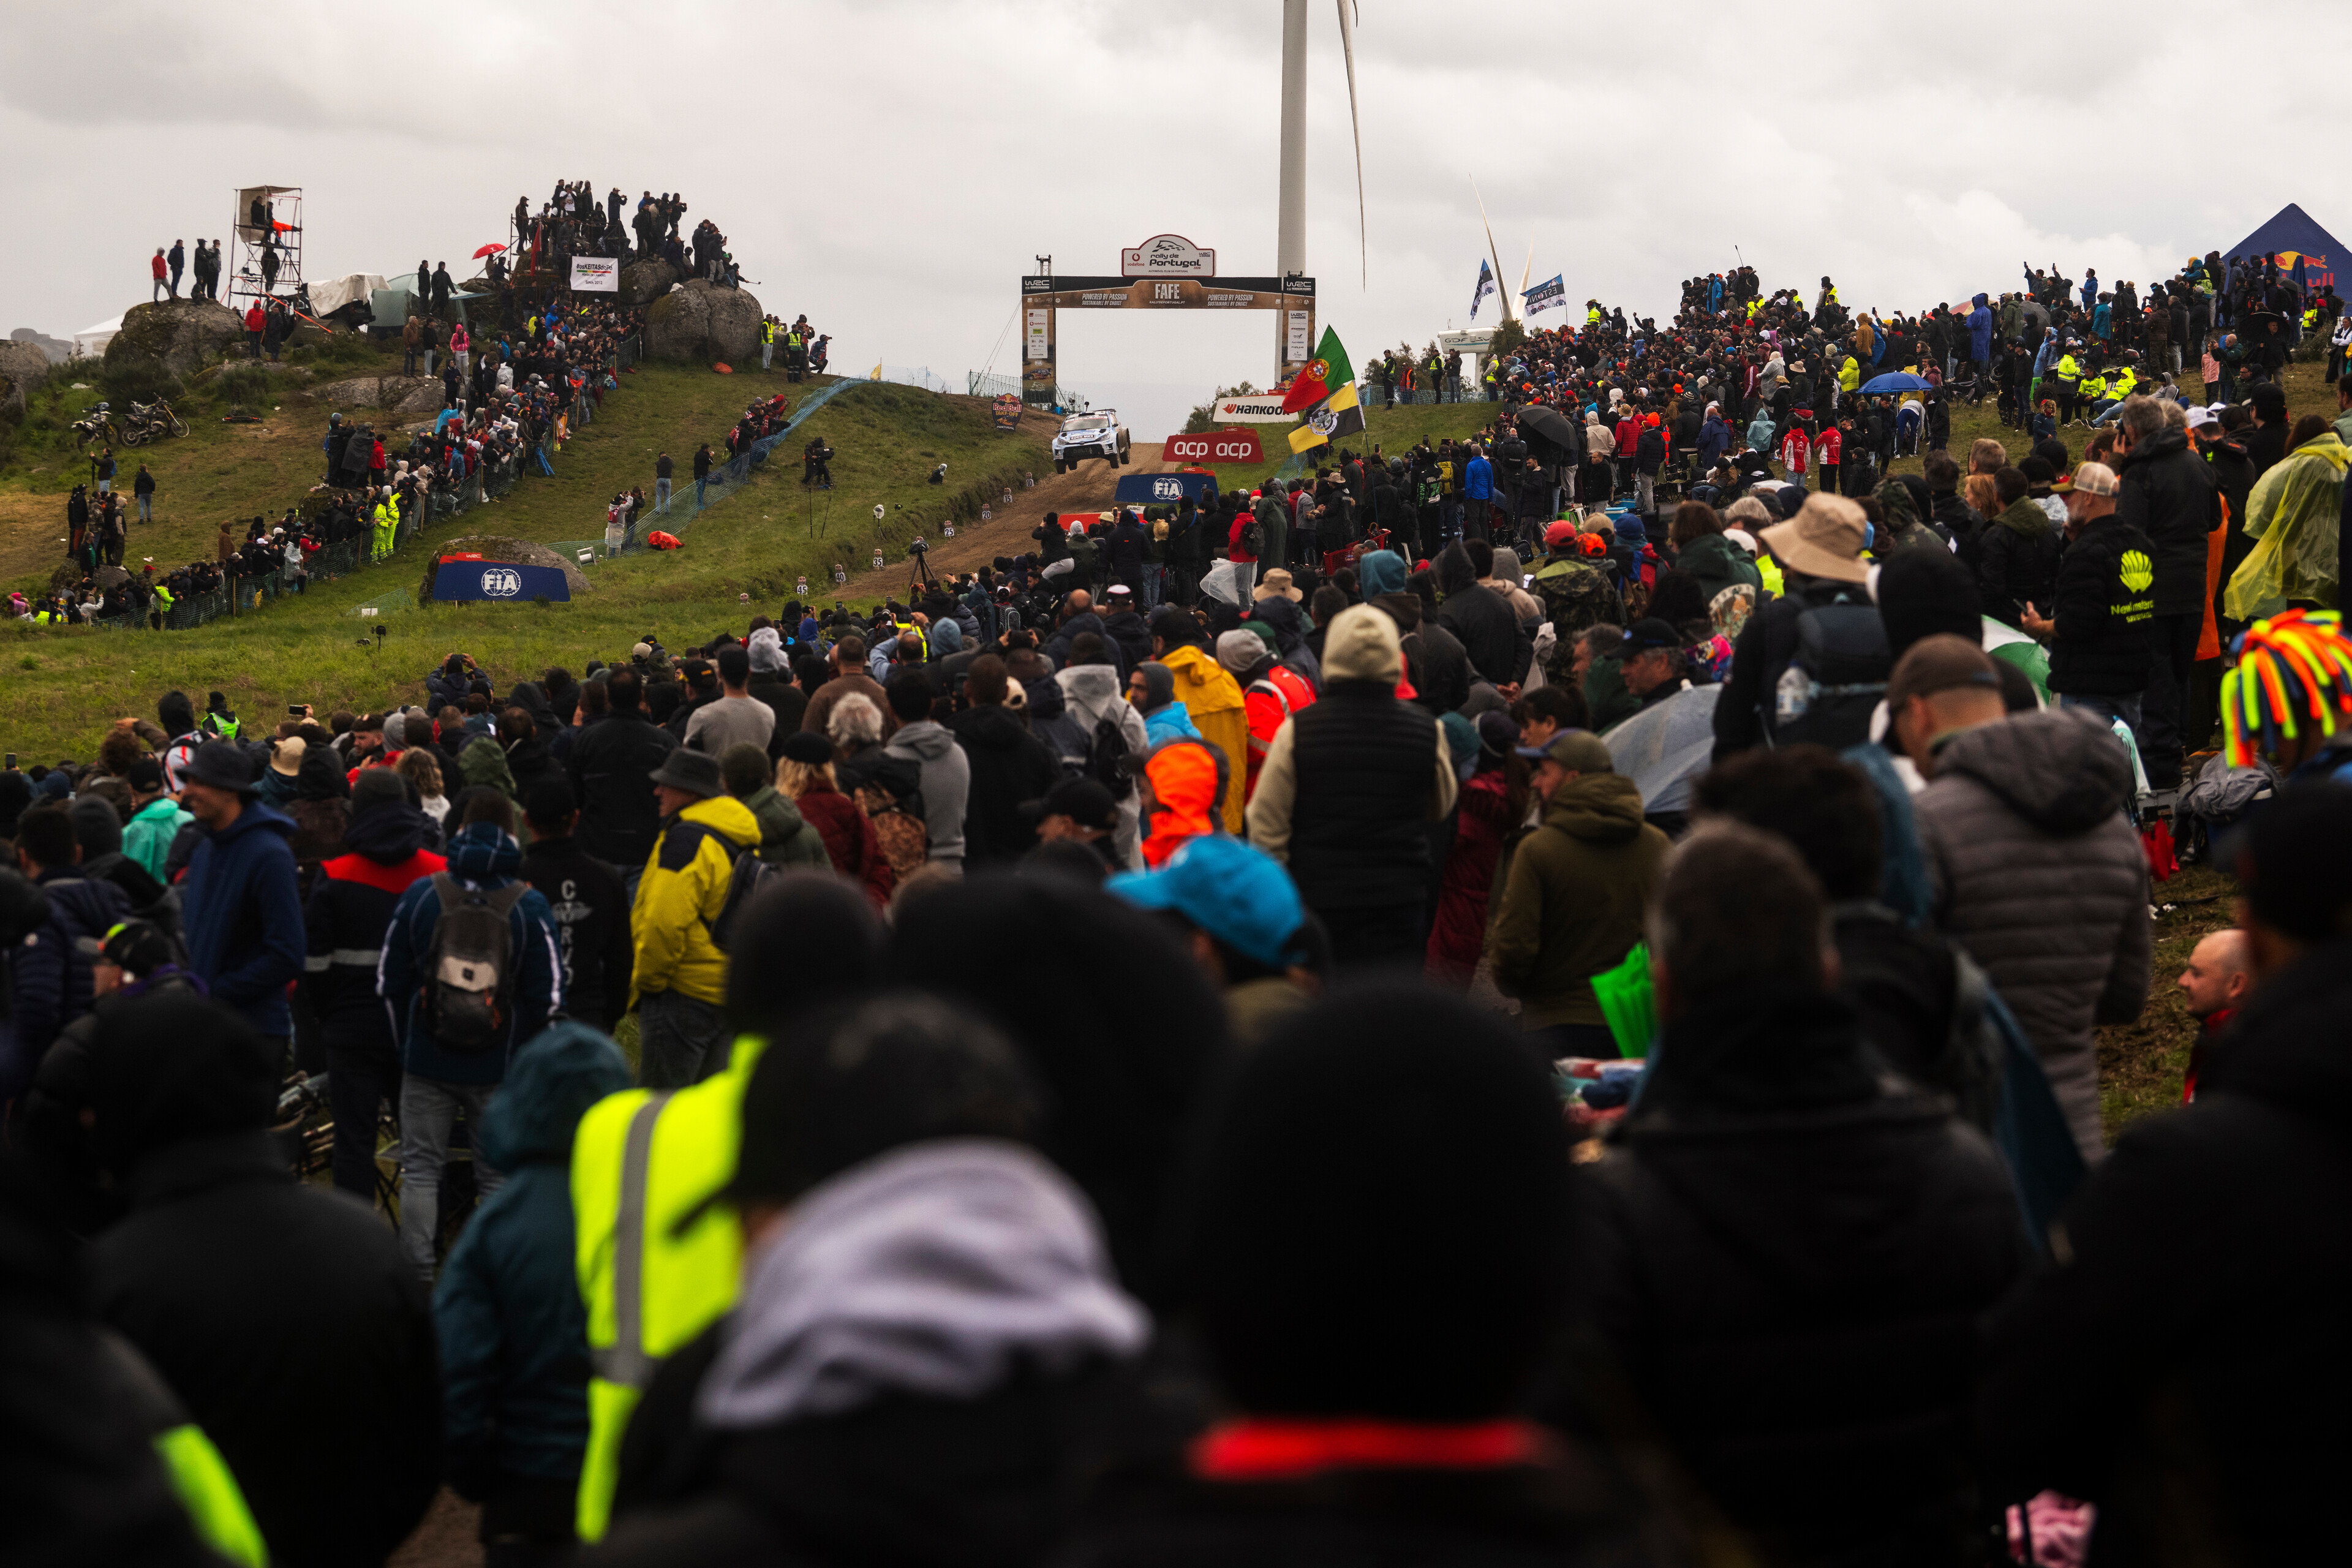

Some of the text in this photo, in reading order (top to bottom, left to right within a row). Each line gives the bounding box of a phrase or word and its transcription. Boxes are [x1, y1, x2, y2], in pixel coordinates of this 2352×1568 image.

[1149, 259, 1201, 268] Portugal
[1155, 284, 1180, 299] FAFE
[1174, 441, 1252, 459] acp acp
